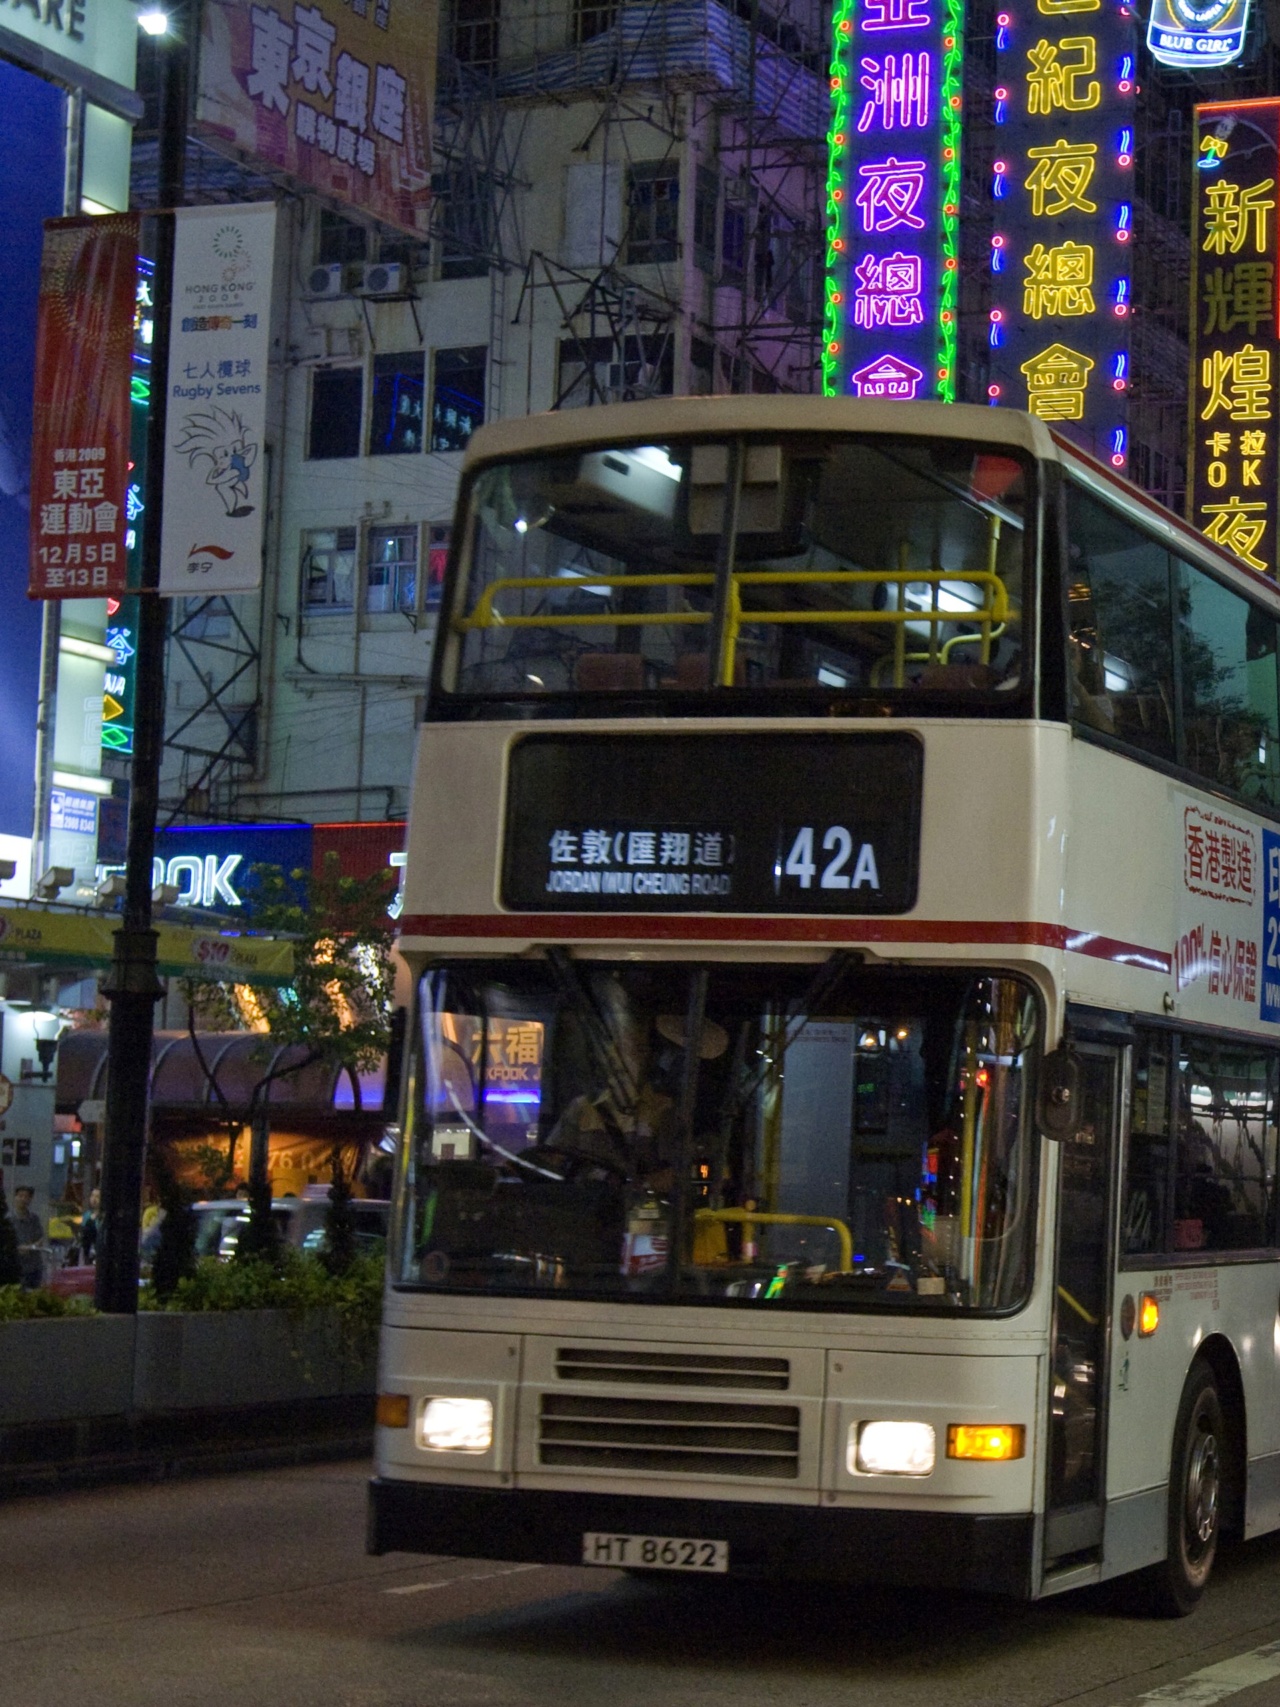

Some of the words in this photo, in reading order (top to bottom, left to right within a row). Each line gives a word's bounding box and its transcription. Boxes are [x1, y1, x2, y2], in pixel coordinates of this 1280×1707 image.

[1159, 33, 1193, 51] BLUE
[1196, 38, 1230, 53] GIRL
[1018, 0, 1103, 421] 紀夜總會
[185, 284, 218, 294] HONG
[221, 282, 254, 292] KONG
[1201, 178, 1275, 421] 新輝煌
[172, 384, 213, 400] Rugby
[217, 383, 261, 396] Sevens
[52, 468, 106, 500] 東亞
[40, 501, 119, 535] 運動會
[39, 542, 116, 564] 12月5日
[44, 566, 108, 588] 至13日
[785, 825, 881, 890] 42A
[1187, 824, 1252, 894] 香港製造
[546, 871, 600, 895] JORDAN
[634, 871, 690, 895] CHEUNG
[593, 1536, 631, 1562] HT
[640, 1539, 717, 1568] 8622
